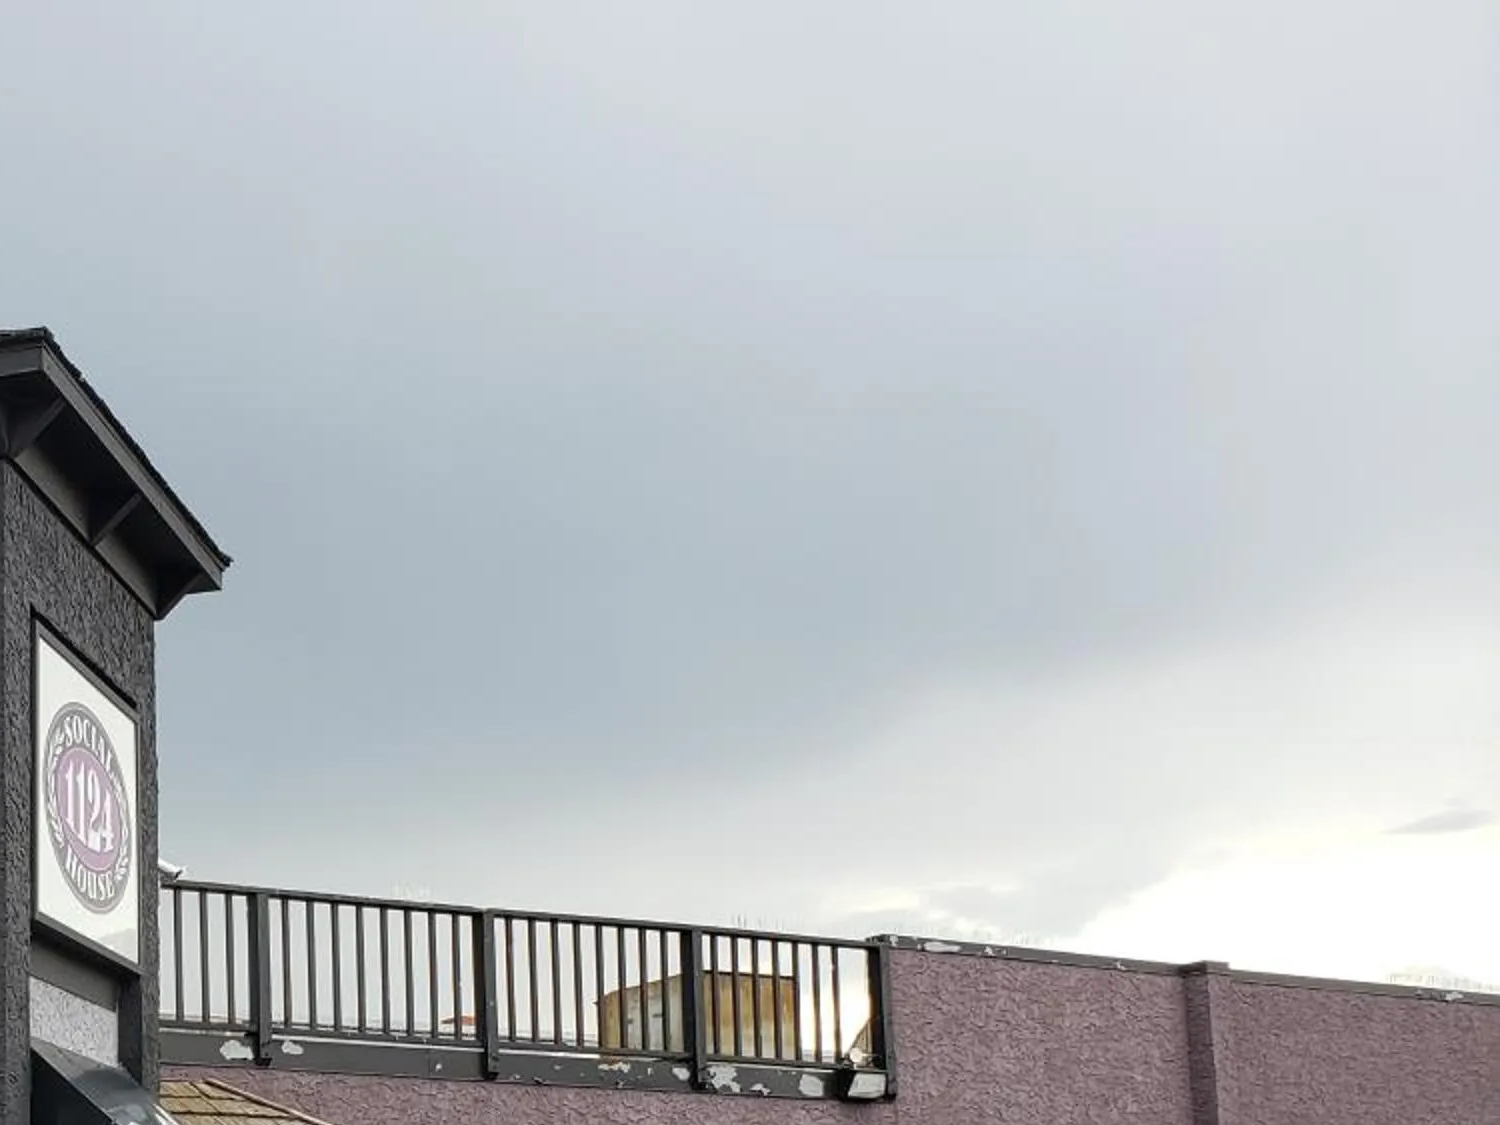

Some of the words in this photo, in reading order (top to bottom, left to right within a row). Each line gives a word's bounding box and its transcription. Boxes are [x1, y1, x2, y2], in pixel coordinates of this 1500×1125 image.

[64, 715, 112, 770] SOCIAL
[65, 759, 114, 852] 1124
[65, 844, 115, 900] HOUSE
